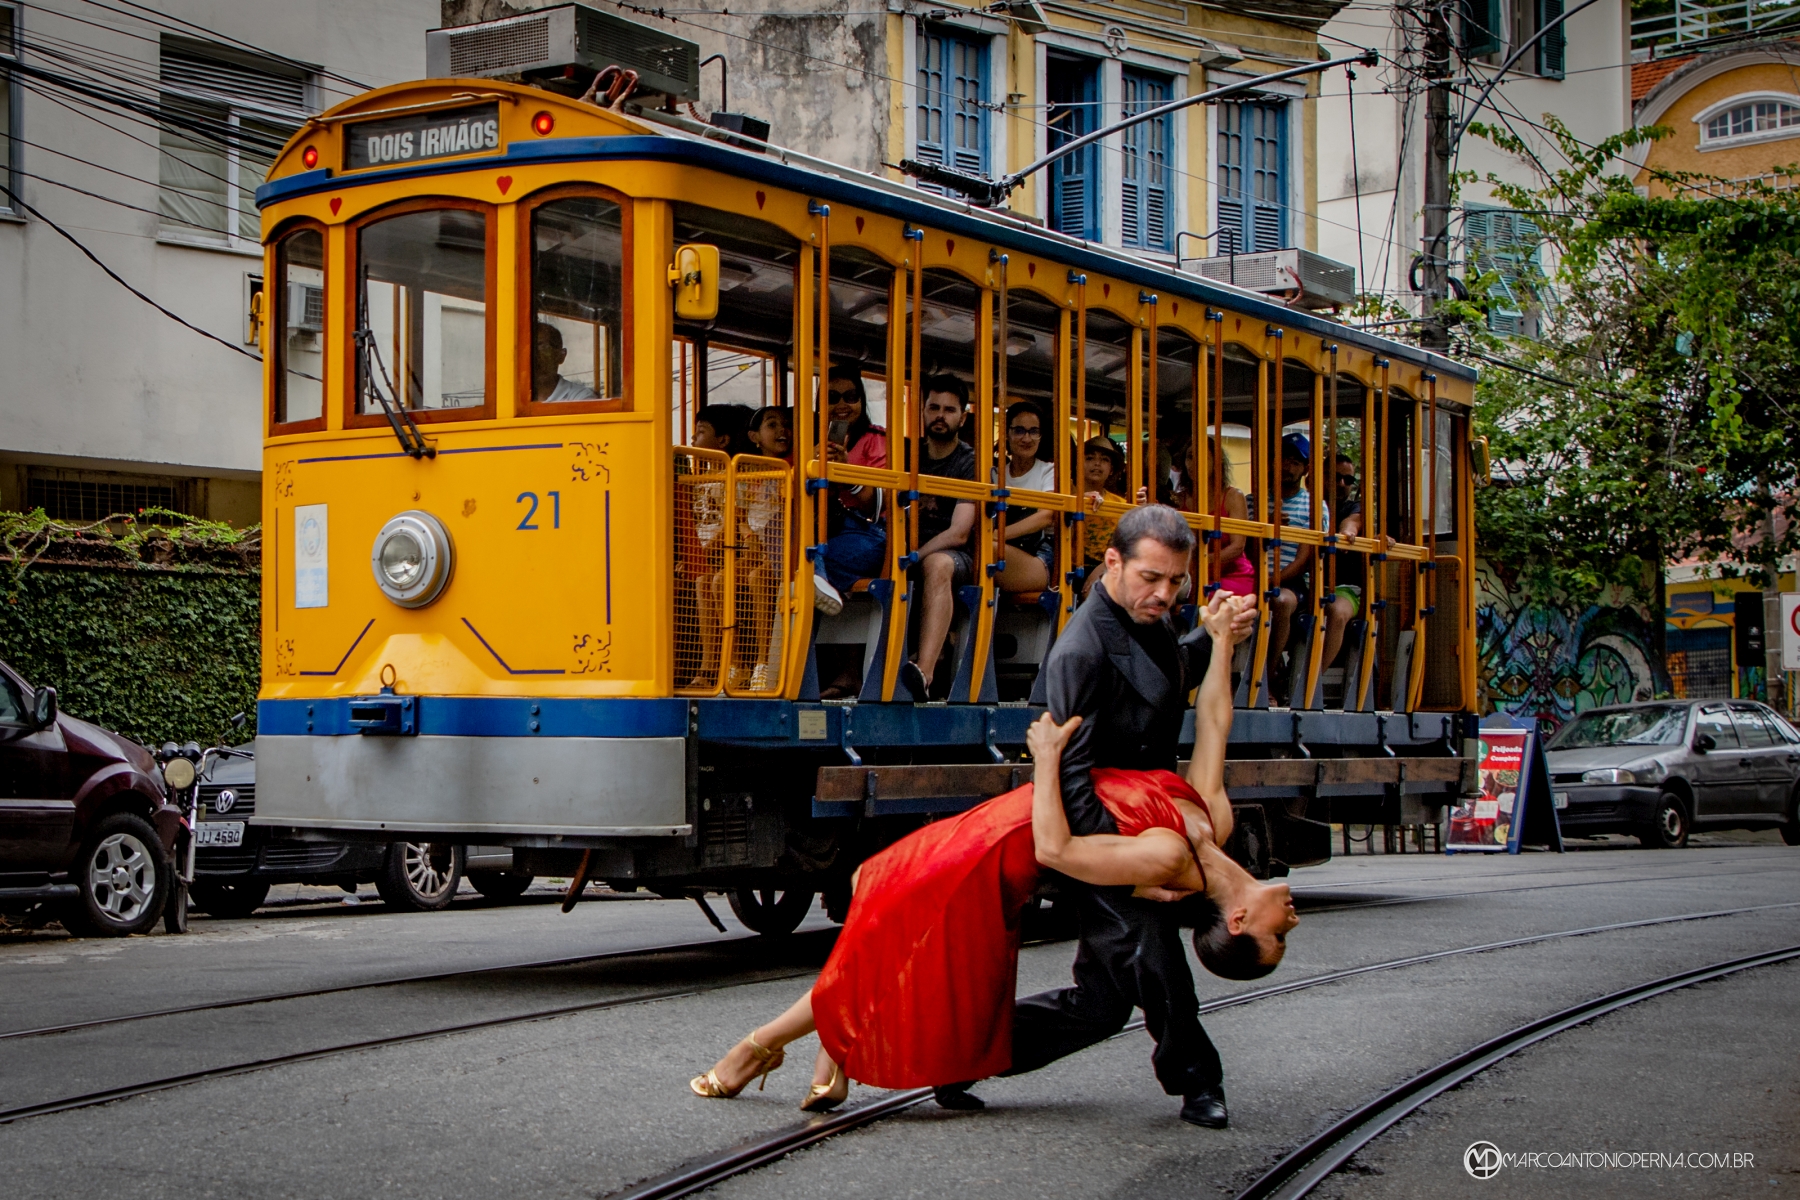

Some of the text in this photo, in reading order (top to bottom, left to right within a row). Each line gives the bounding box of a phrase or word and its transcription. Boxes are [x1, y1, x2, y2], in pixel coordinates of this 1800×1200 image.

[368, 118, 498, 163] DOIS IRMÃOS
[516, 491, 560, 530] 21
[1492, 745, 1522, 753] Feijoada
